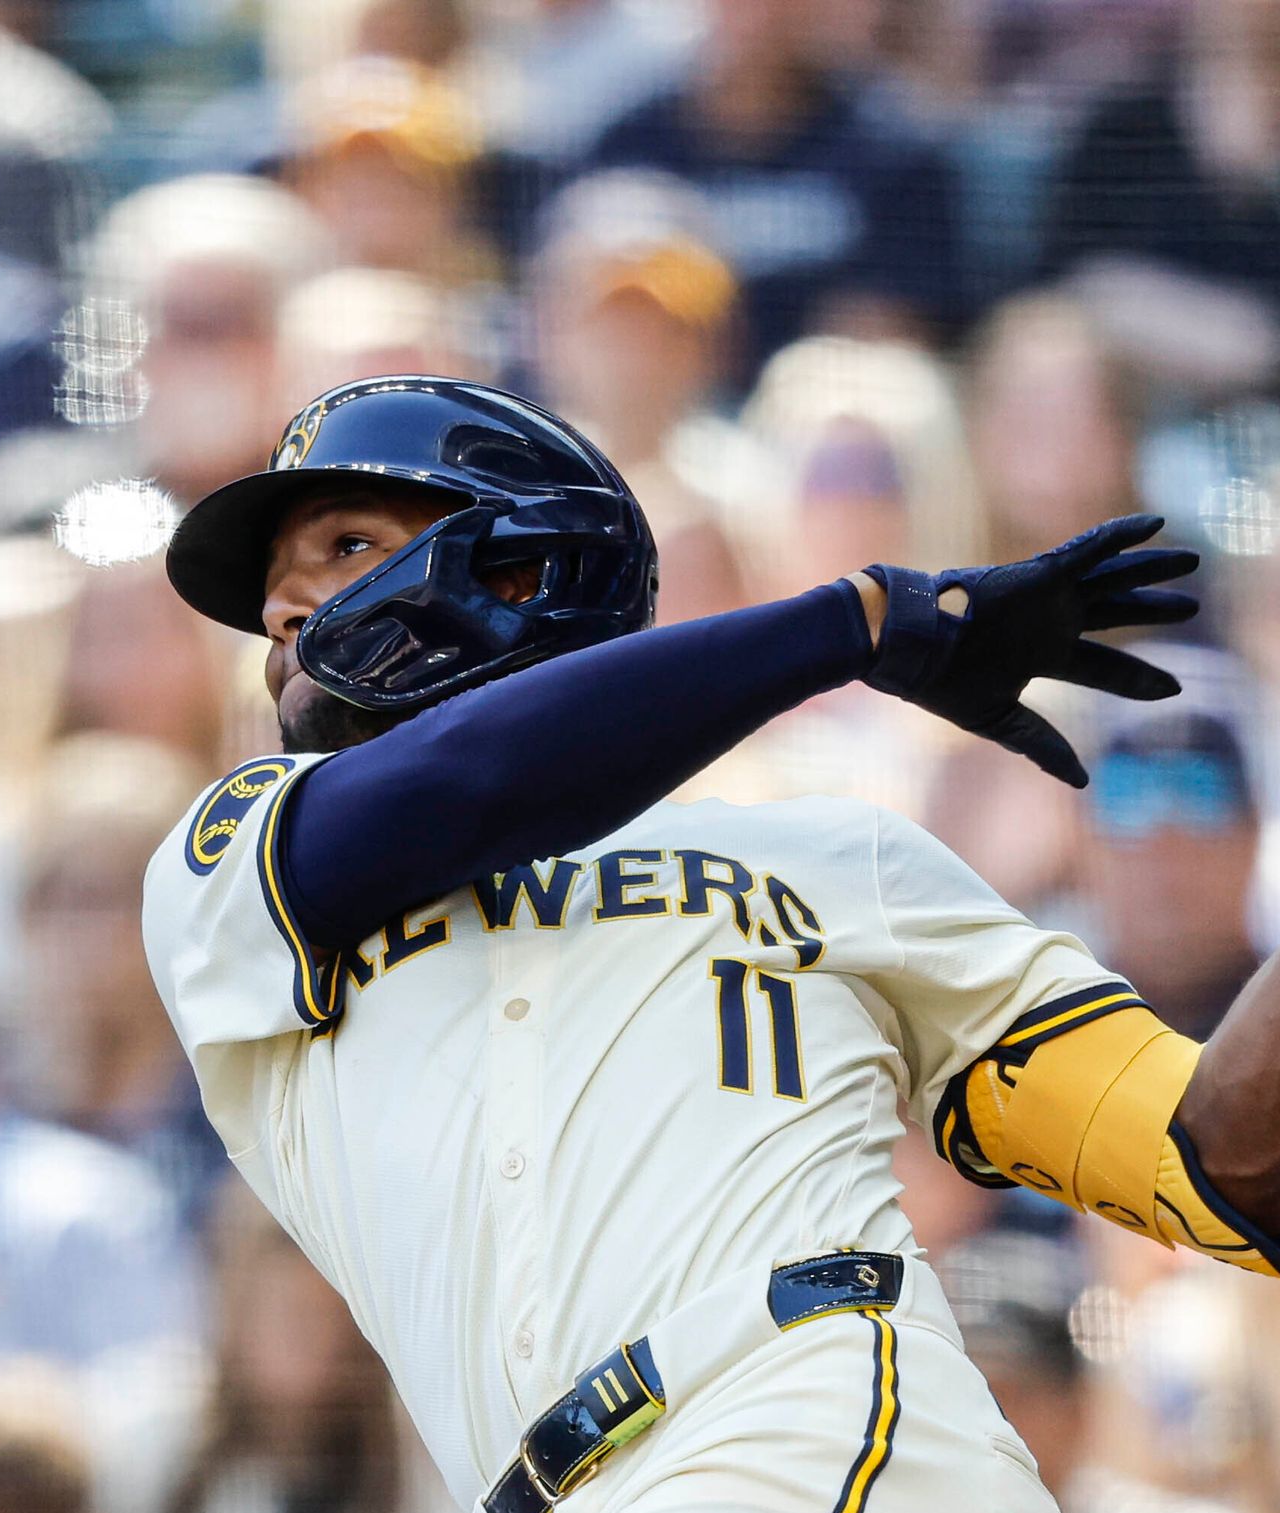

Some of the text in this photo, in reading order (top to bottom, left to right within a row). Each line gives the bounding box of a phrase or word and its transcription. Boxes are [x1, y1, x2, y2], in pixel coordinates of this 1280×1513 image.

[310, 848, 827, 1043] WERS
[707, 956, 808, 1104] 11
[591, 1368, 630, 1413] 11
